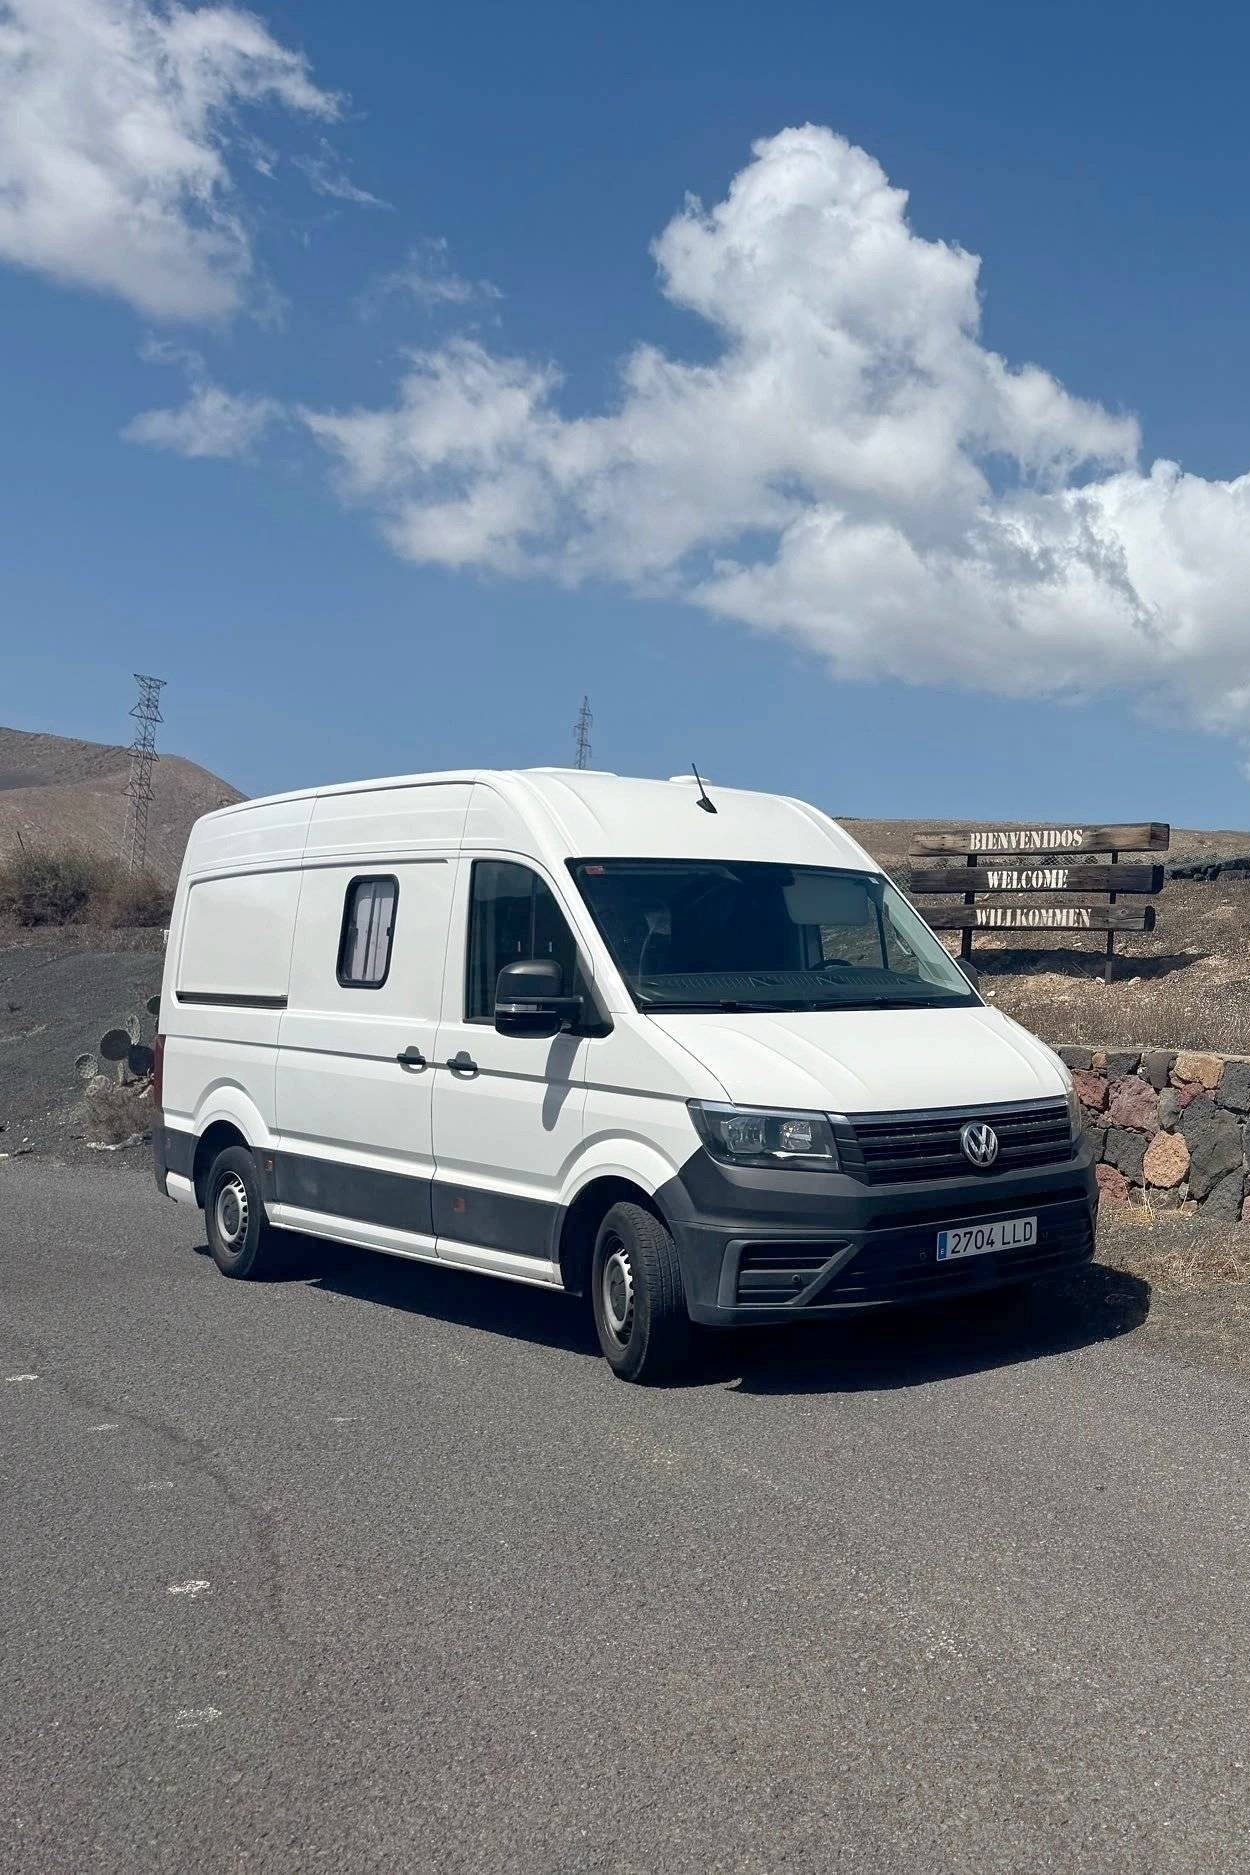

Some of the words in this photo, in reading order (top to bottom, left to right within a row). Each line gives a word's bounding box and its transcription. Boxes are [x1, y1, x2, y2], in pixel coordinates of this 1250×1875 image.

[970, 829, 1083, 850] BIENVENIDOS
[987, 869, 1068, 889] WELCOME
[976, 908, 1092, 928] WILLKOMMEN
[951, 1227, 995, 1255] 2704
[1002, 1221, 1033, 1246] LLD
